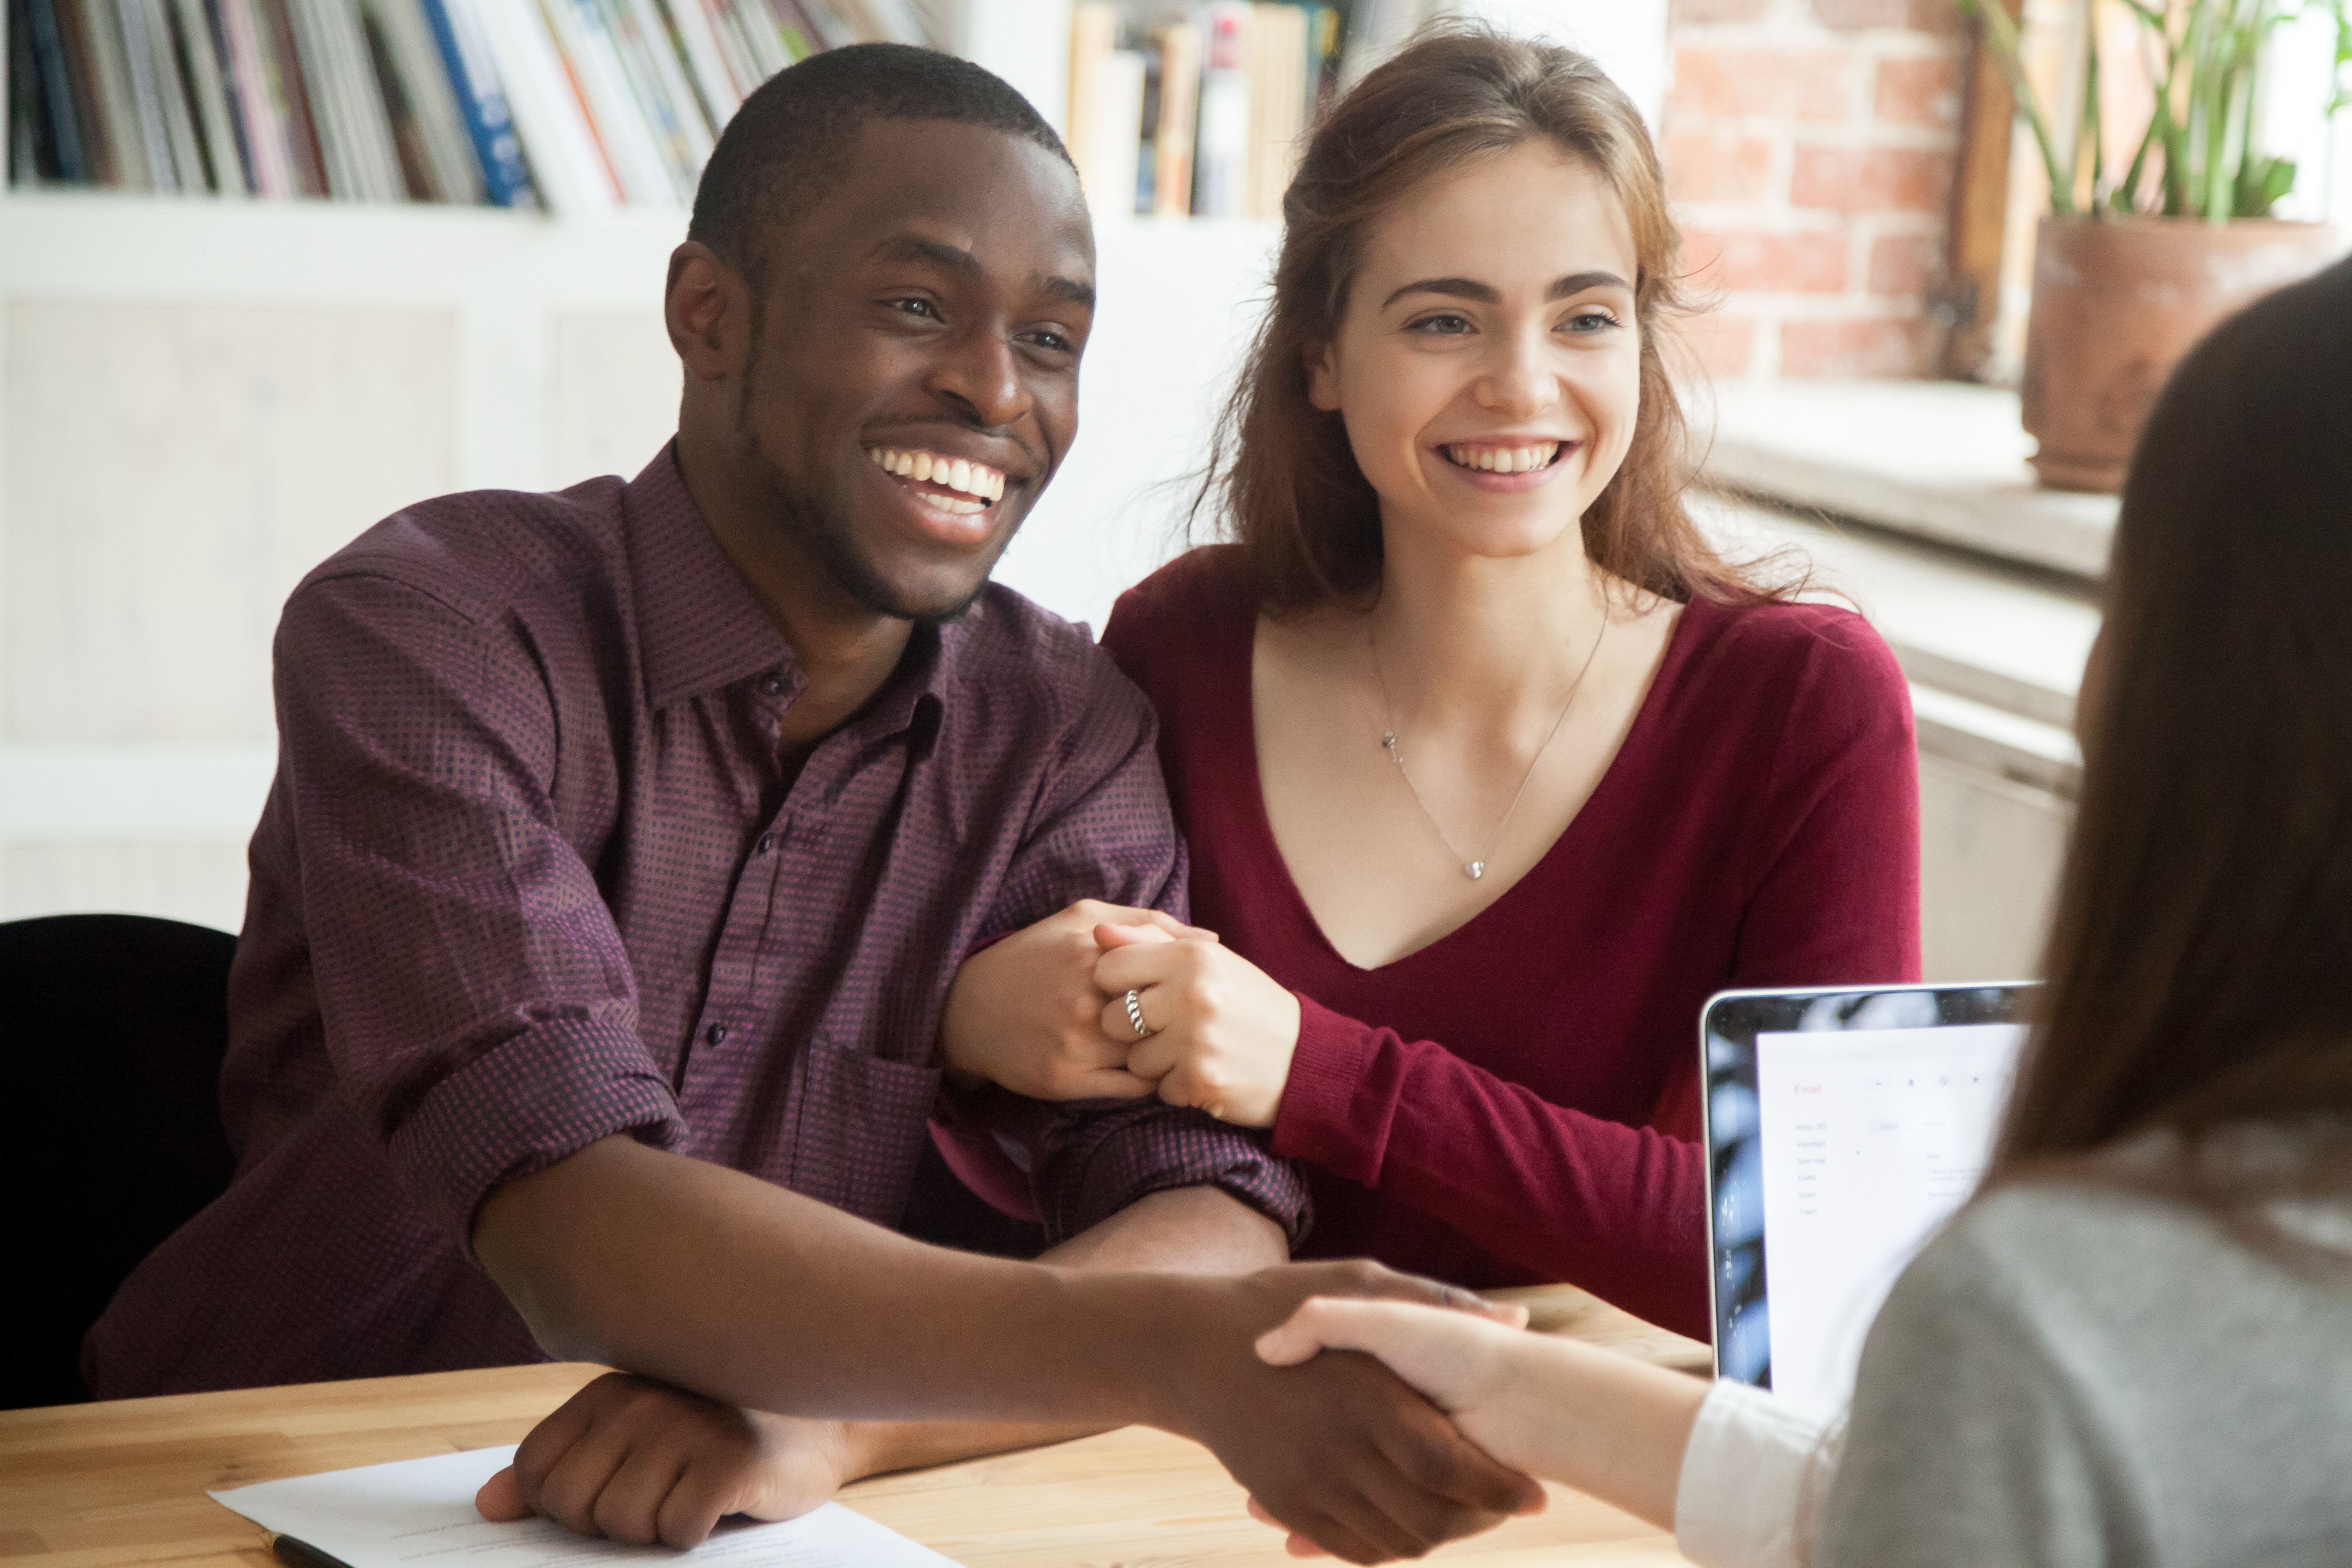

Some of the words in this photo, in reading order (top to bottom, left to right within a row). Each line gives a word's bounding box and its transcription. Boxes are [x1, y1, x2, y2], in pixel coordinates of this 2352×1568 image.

[1794, 1083, 1822, 1095] Email
[1815, 1123, 1828, 1131] (20)
[1796, 1140, 1826, 1149] Important
